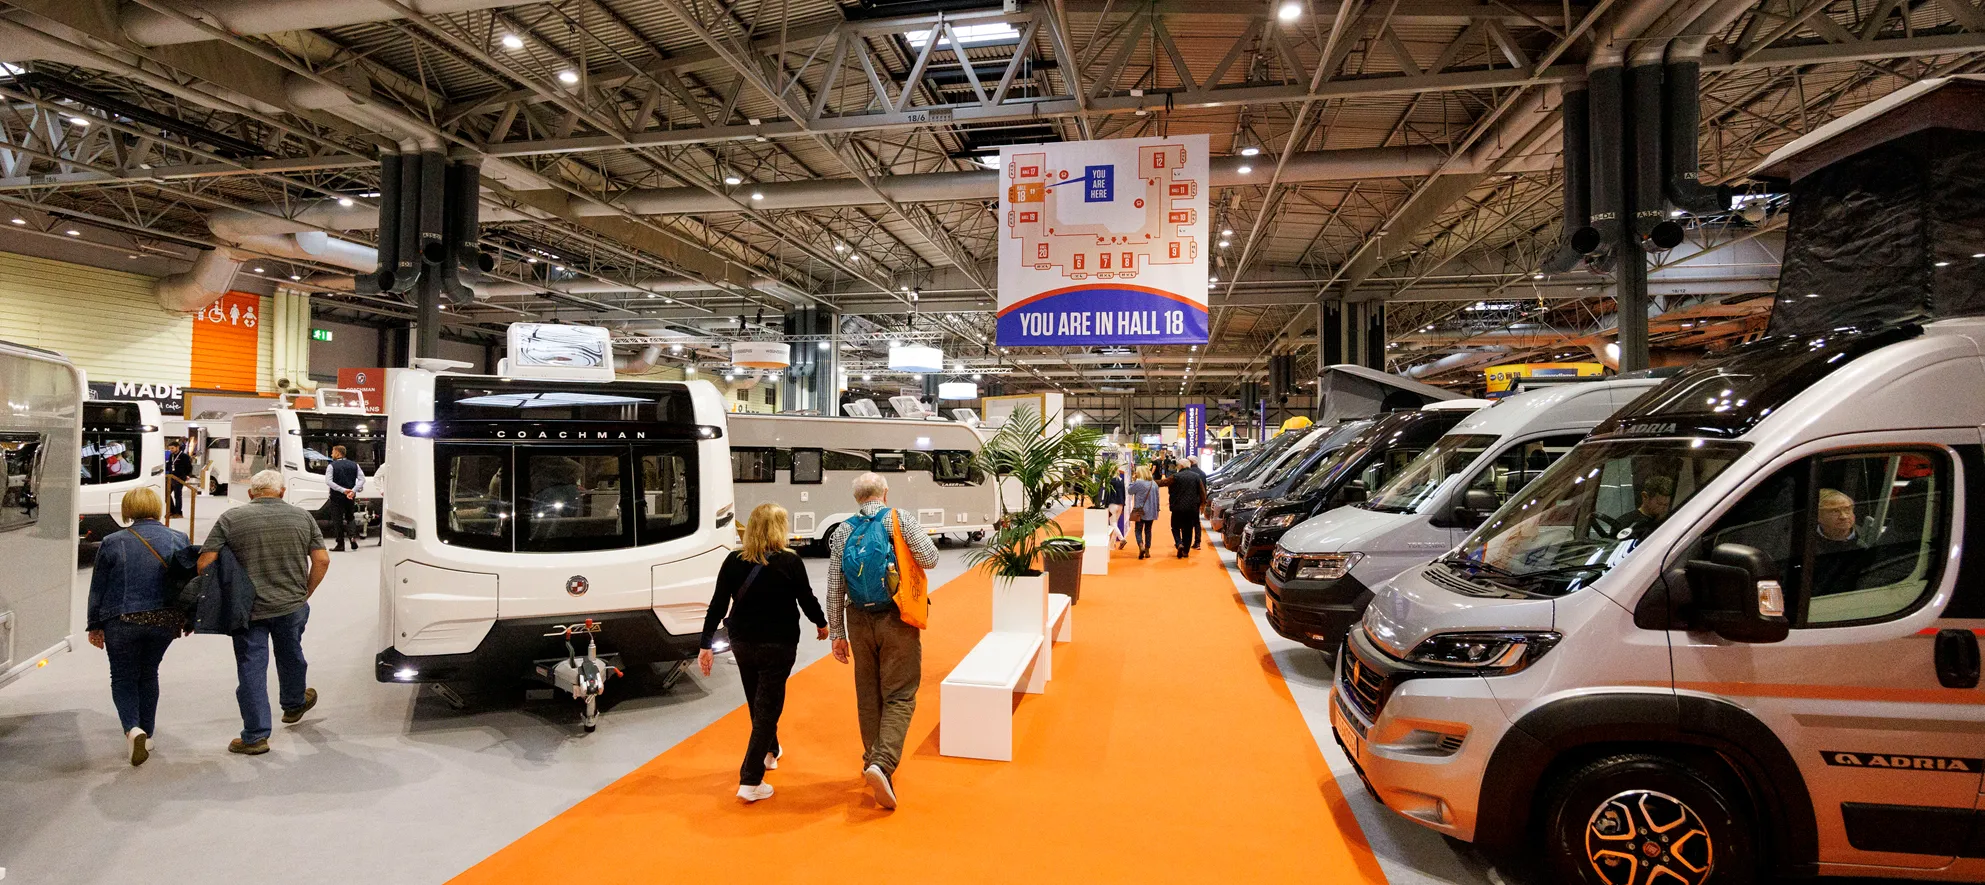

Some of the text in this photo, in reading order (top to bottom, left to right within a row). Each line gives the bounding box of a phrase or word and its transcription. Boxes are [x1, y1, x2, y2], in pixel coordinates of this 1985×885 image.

[907, 114, 926, 122] 18/6
[1156, 158, 1163, 167] 12
[1030, 167, 1036, 175] 17
[1092, 169, 1106, 179] YOU
[1092, 179, 1106, 189] ARE
[1090, 189, 1108, 199] HERE
[1180, 186, 1185, 194] 11
[1017, 190, 1026, 202] 18
[1039, 249, 1047, 258] 20
[1172, 247, 1177, 256] 9
[1076, 259, 1082, 268] 6
[1104, 259, 1108, 268] 7
[1124, 258, 1130, 267] 8
[1020, 310, 1184, 336] YOU ARE IN HALL 18
[114, 380, 183, 399] MADE
[1625, 422, 1677, 434] ADRIA
[497, 431, 646, 439] COACHMAN
[1868, 755, 1970, 771] ADRIA
